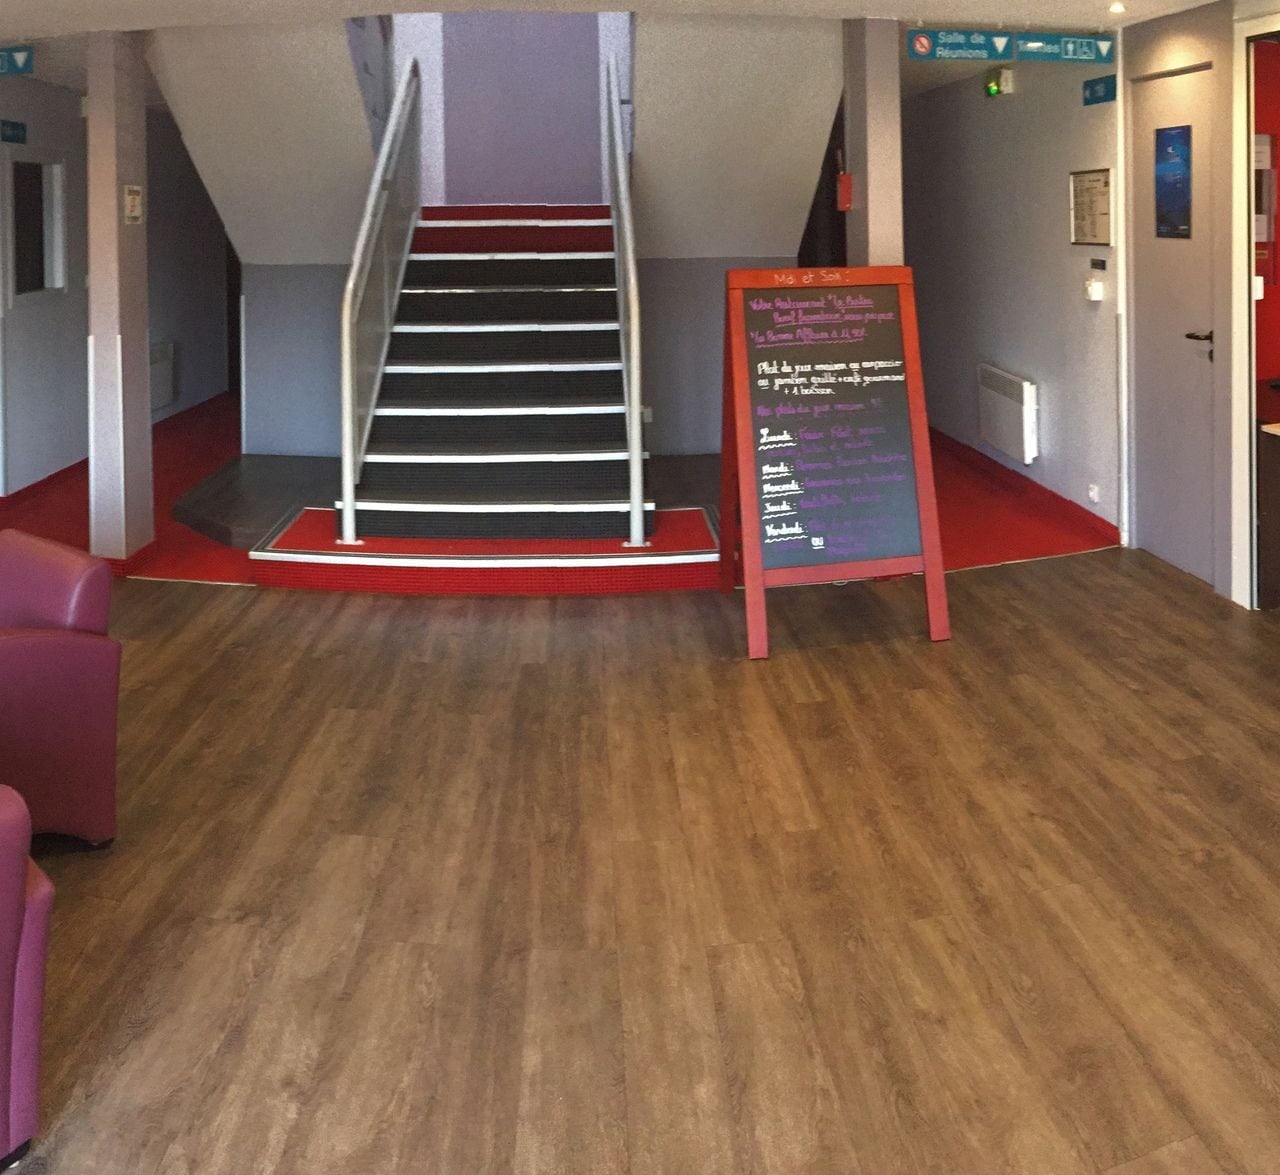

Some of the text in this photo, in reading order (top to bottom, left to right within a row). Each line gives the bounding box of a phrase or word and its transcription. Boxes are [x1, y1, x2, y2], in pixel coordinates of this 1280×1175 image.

[938, 32, 986, 44] Salle de
[935, 46, 989, 58] Réunions
[757, 360, 780, 375] Plat
